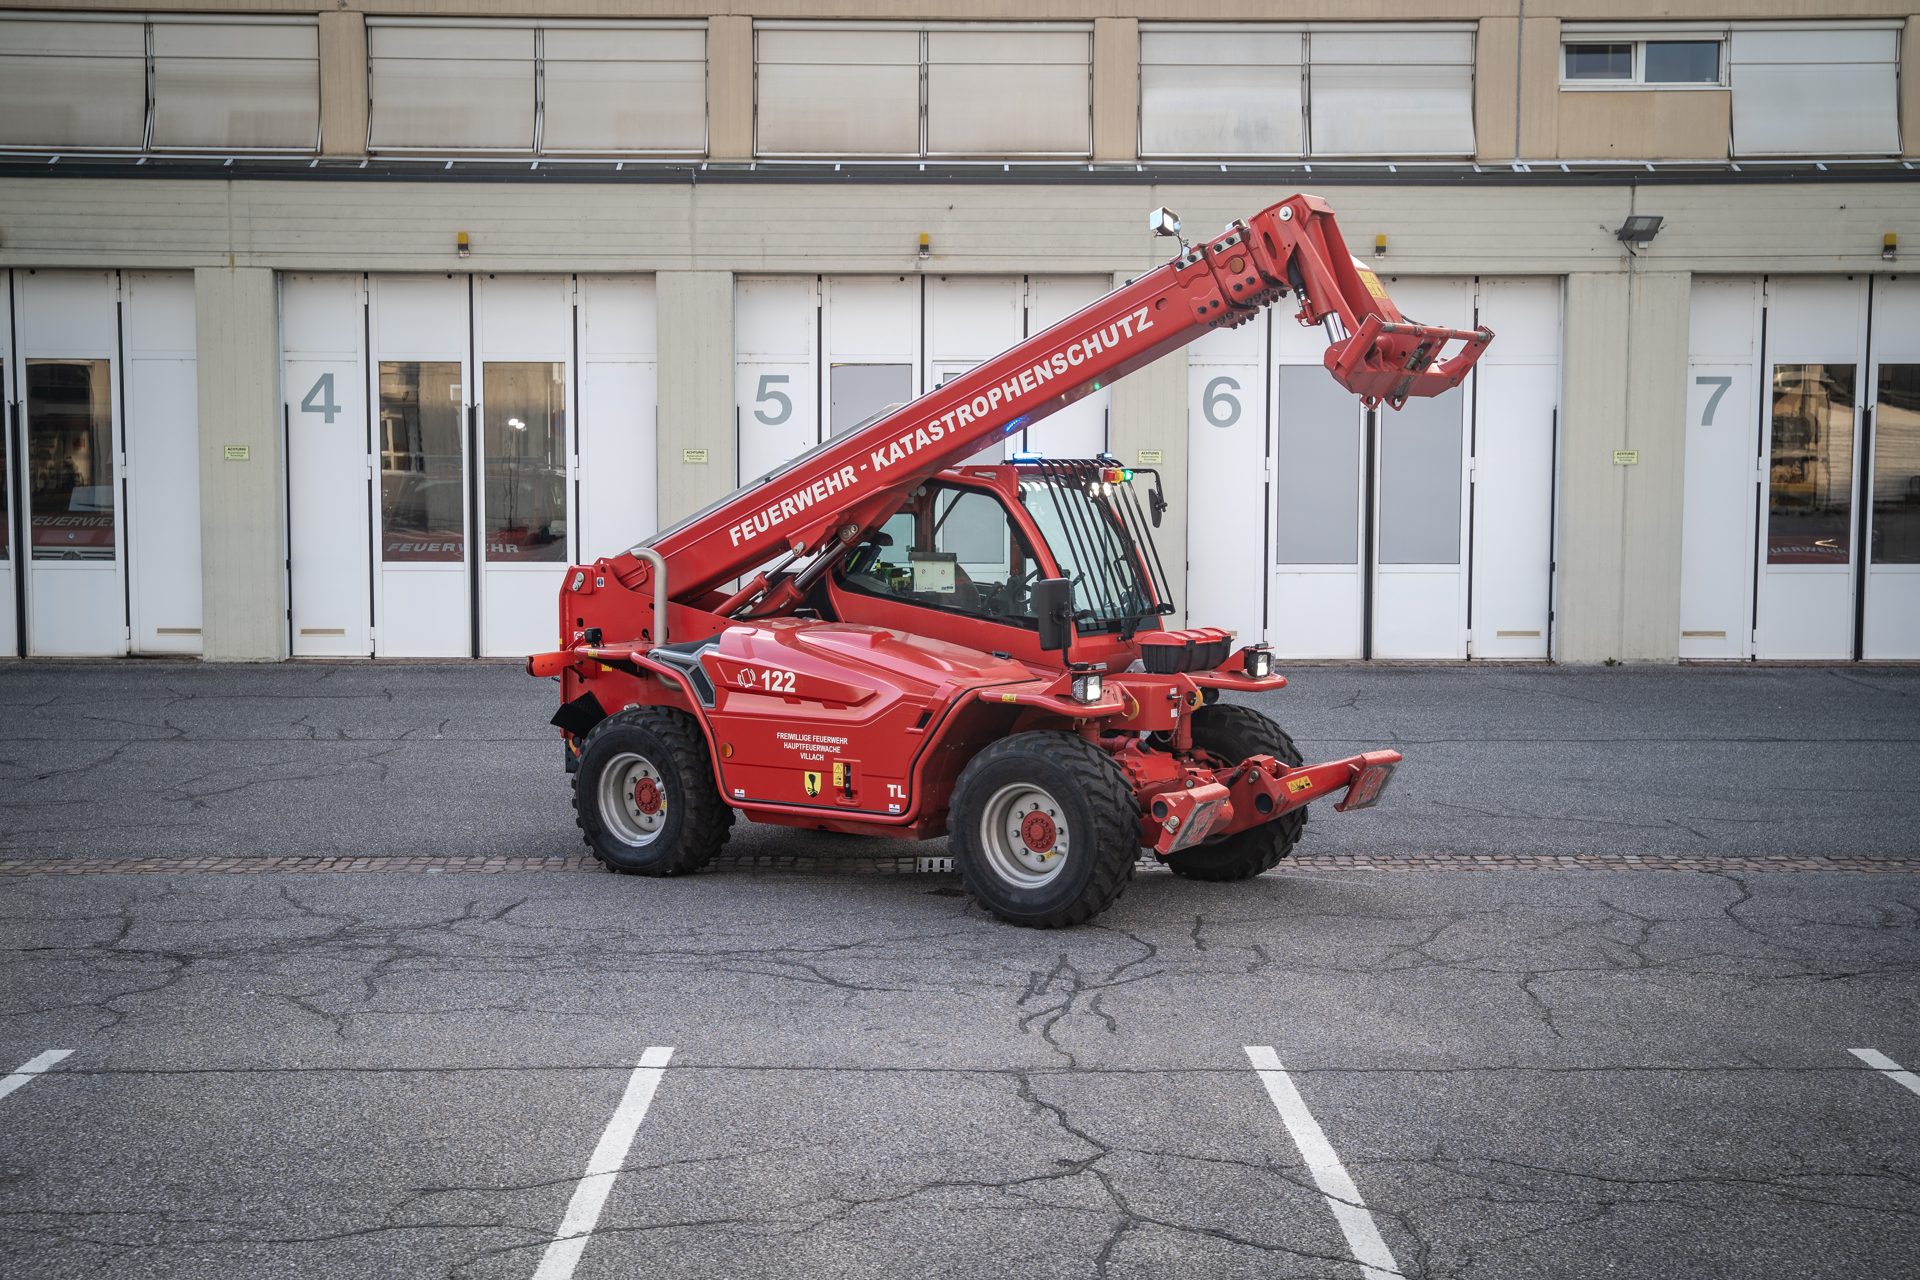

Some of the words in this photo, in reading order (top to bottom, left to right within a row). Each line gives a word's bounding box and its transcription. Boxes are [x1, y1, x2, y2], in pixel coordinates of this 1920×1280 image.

[301, 373, 341, 424] 4
[754, 375, 792, 425] 5
[1203, 376, 1241, 427] 6
[1696, 376, 1733, 426] 7
[729, 465, 858, 547] FEUERWEHR
[870, 306, 1154, 472] KATASTROPHENSCHUTZ
[32, 515, 114, 526] EUERWE
[387, 543, 519, 553] FEUERHR
[1768, 547, 1849, 555] UERWEHR
[761, 670, 796, 693] 122
[776, 732, 812, 742] FREIWILLIGE
[812, 735, 848, 745] FEUERWEHR
[783, 742, 841, 753] HAUPTFEUERWACHE
[800, 752, 824, 762] VILLACH
[887, 784, 906, 798] TL
